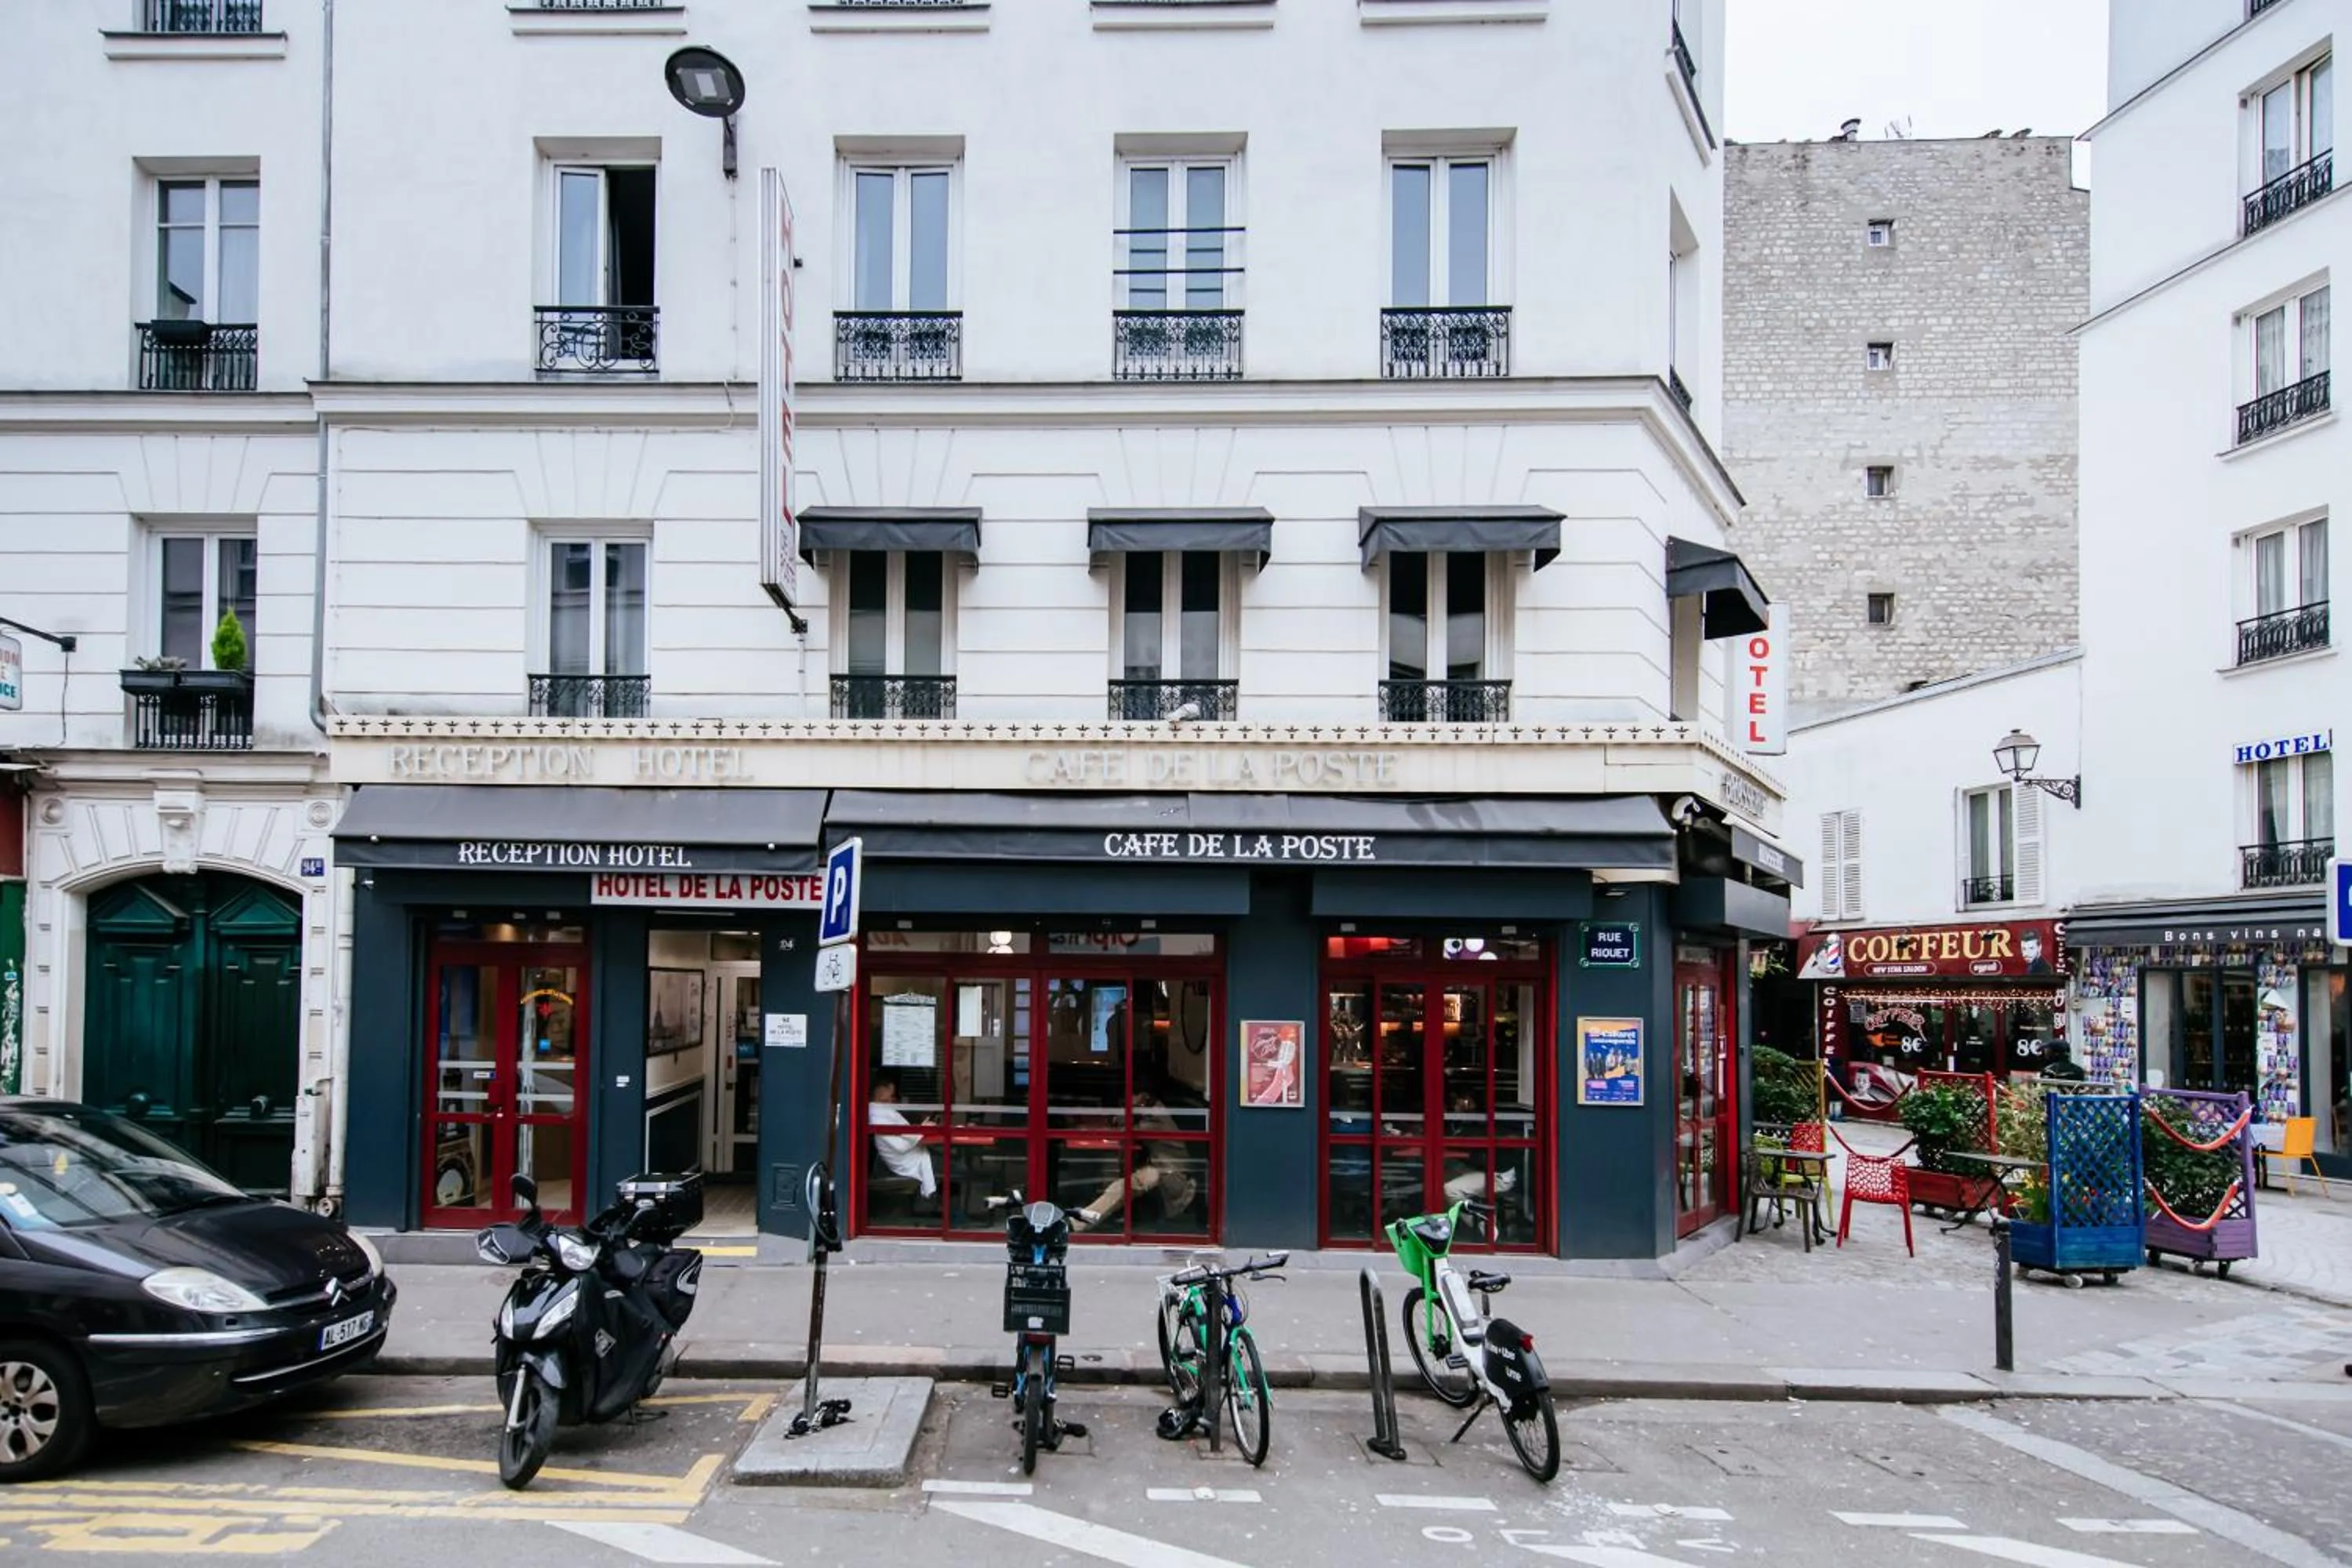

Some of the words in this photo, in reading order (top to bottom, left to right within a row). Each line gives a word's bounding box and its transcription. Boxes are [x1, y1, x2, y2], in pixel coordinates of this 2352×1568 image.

[1748, 637, 1770, 742] OTEL
[390, 744, 594, 779] RECEPTION
[633, 746, 754, 782] HOTEL
[1024, 751, 1126, 785] CAFE
[1145, 751, 1194, 785] DE
[1207, 751, 1258, 785] LA
[1272, 751, 1401, 787] POSTE
[458, 841, 600, 866] RECEPTION
[608, 845, 692, 867] HOTEL
[1103, 833, 1180, 858] CAFE
[1188, 833, 1226, 858] DE
[1233, 835, 1274, 859] LA
[1279, 835, 1377, 860] POSTE
[597, 873, 672, 898] HOTEL
[678, 874, 709, 899] DE
[713, 875, 742, 901] LA
[750, 876, 823, 902] POSTE
[829, 866, 847, 924] P
[1597, 932, 1622, 942] RUE
[1848, 928, 2014, 962] COIFFEUR
[2165, 931, 2215, 941] Bons
[2230, 927, 2279, 938] vins
[2296, 927, 2322, 938] na
[1590, 948, 1630, 959] RIQUET
[1901, 1036, 1923, 1053] 8€
